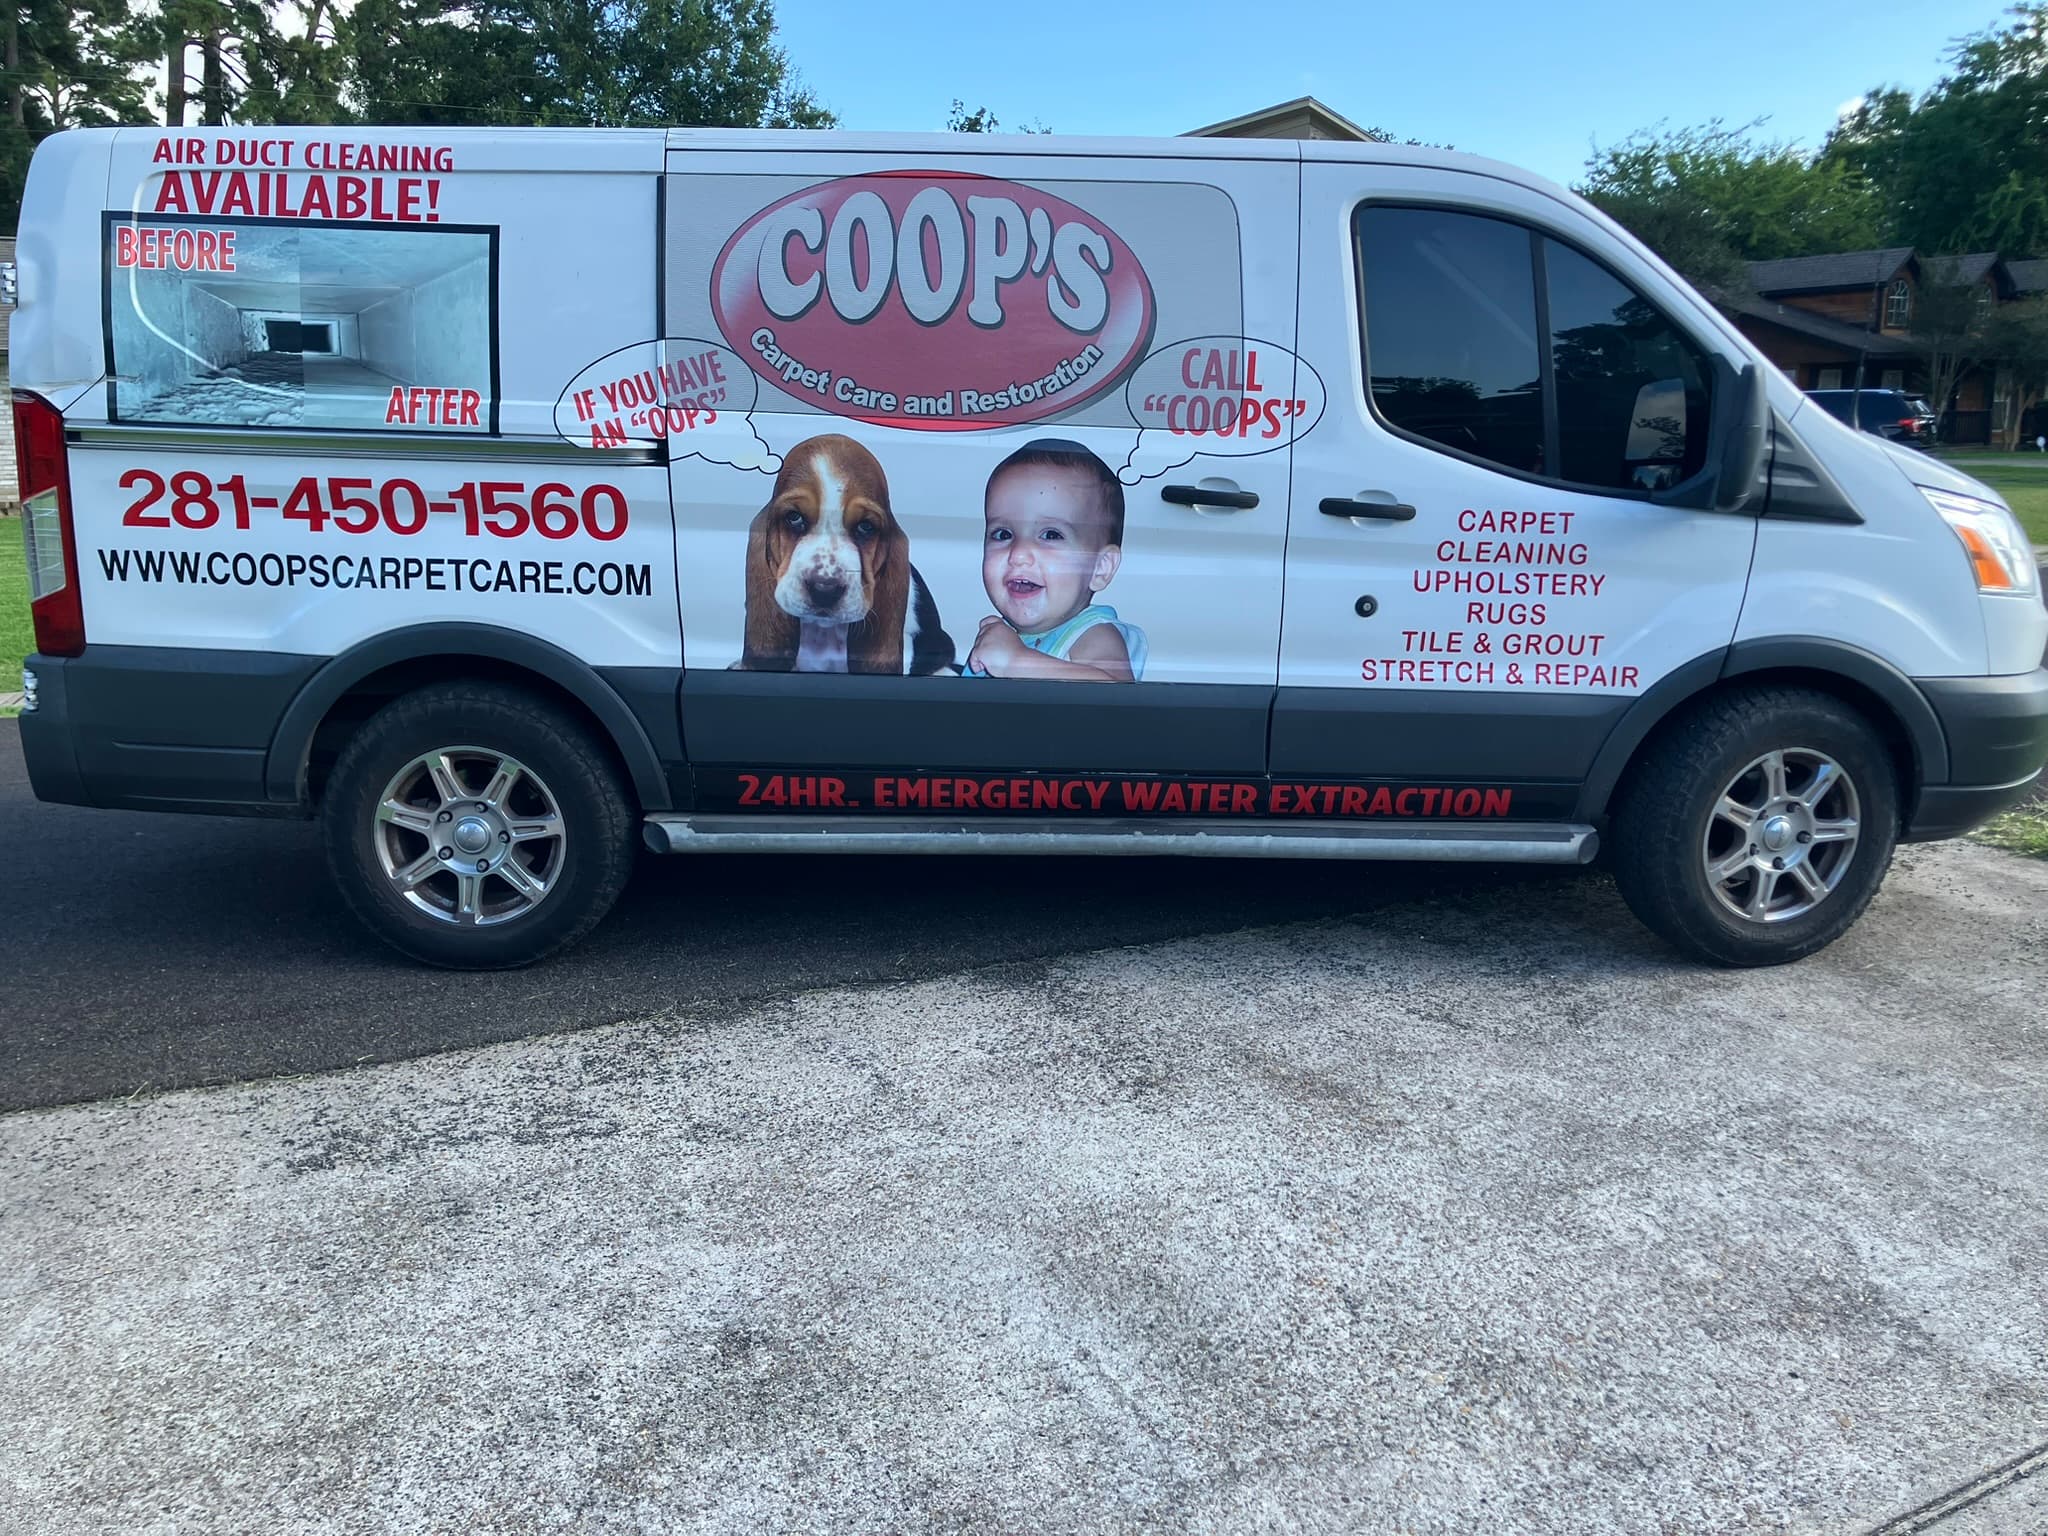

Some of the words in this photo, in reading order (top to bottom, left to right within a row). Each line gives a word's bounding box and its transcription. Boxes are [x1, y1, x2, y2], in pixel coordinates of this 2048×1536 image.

[153, 138, 206, 166] AIR
[215, 139, 294, 168] DUCT
[304, 142, 453, 173] CLEANING
[155, 170, 440, 221] AVAILABLE!
[116, 227, 236, 272] BEFORE
[756, 187, 1113, 335] COOP'S
[573, 389, 596, 422] IF
[600, 371, 657, 413] YOU
[658, 350, 726, 397] HAVE
[750, 327, 832, 395] Carpet
[834, 377, 896, 412] Care
[903, 392, 953, 415] and
[960, 343, 1104, 415] Restoration
[1181, 348, 1263, 392] CALL
[385, 387, 481, 426] AFTER
[591, 417, 628, 449] AN
[117, 468, 629, 541] 281-450-1560
[1457, 510, 1575, 535] CARPET
[97, 549, 652, 597] WWW.COOPSCARPETCARE.COM
[1436, 540, 1589, 566] CLEANING
[1413, 570, 1606, 597] UPHOLSTERY
[1467, 602, 1546, 625] RUGS
[1402, 631, 1462, 654] TILE
[1473, 632, 1492, 654] &
[1503, 634, 1605, 658] GROUT
[1361, 659, 1493, 683] STRETCH
[1506, 662, 1524, 685] &
[1535, 663, 1639, 688] REPAIR
[737, 773, 858, 808] 24HR.
[874, 778, 1111, 811] EMERGENCY
[1121, 783, 1258, 815] WATER
[1269, 785, 1511, 819] EXTRACTION
